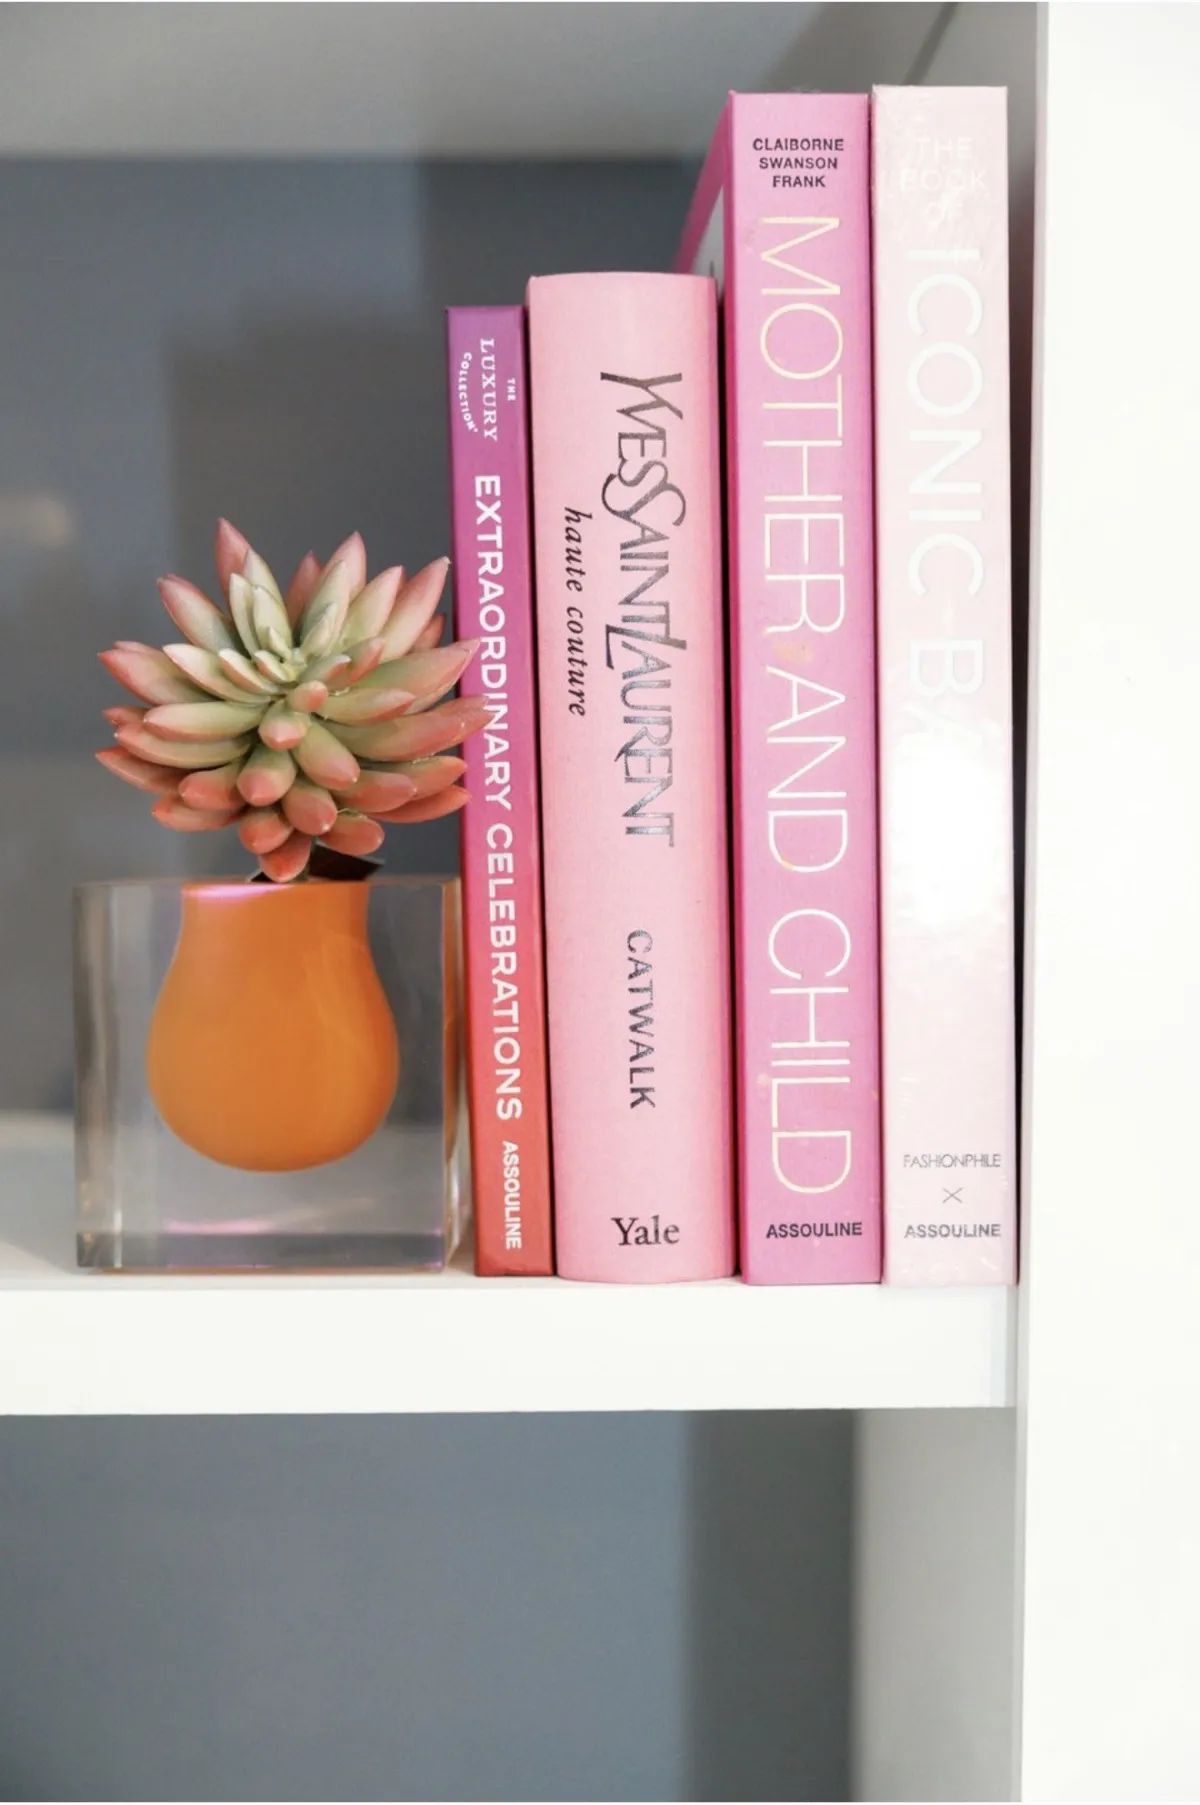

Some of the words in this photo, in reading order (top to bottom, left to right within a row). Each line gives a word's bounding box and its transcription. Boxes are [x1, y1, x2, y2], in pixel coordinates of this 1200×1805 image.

[752, 138, 845, 152] CLAIBORNE
[758, 157, 838, 170] SWANSON
[772, 175, 826, 188] FRANK
[480, 337, 498, 442] LUXURY
[507, 377, 516, 402] THE
[760, 216, 846, 634] MOTHER
[906, 249, 985, 597] ICONIC
[564, 506, 593, 593] haute
[474, 474, 513, 811] EXTRAORDINARY
[565, 606, 587, 717] couture
[766, 665, 848, 873] AND
[486, 823, 523, 1121] CELEBRATIONS
[626, 929, 657, 1109] CATWALK
[768, 908, 852, 1194] CHILD
[502, 1140, 522, 1250] ASSOULINE
[903, 1153, 1002, 1169] FASHIONPHILE
[610, 1214, 681, 1247] Yale
[765, 1221, 863, 1239] ASSOULINE
[904, 1223, 1002, 1238] ASSOULINE
